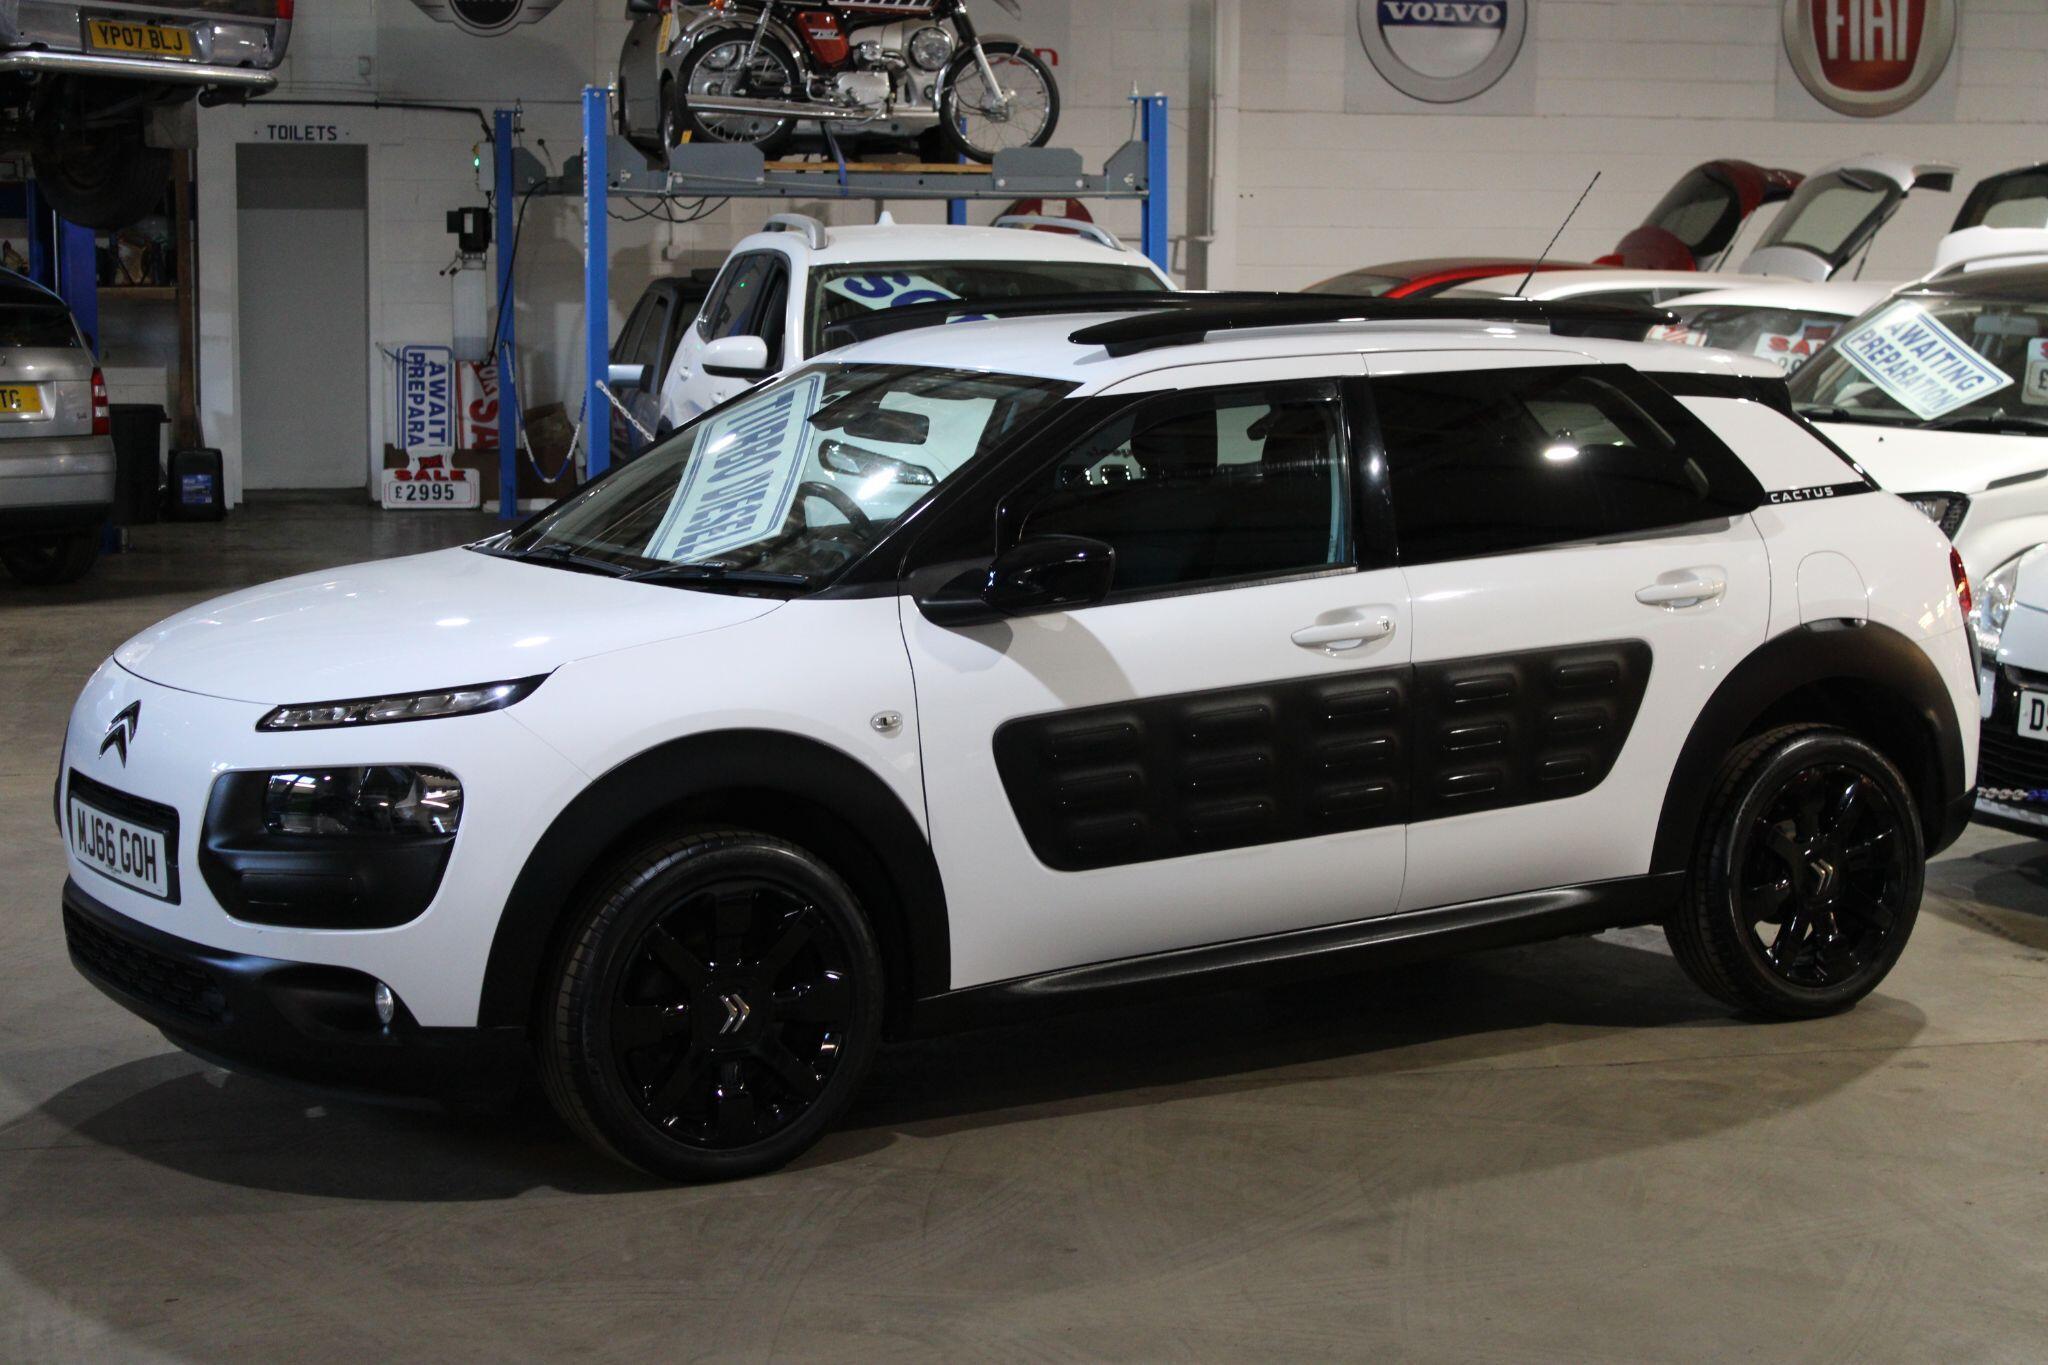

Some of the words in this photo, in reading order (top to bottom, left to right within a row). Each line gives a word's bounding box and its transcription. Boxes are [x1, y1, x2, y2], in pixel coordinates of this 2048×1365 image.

[97, 24, 143, 48] YP07
[147, 29, 183, 51] BLJ
[1383, 1, 1501, 24] VOLVO
[266, 124, 337, 141] TOILETS
[1852, 328, 1960, 409] PREPARATION
[1886, 320, 1985, 391] AWAITING
[428, 360, 446, 447] AWAIT
[707, 389, 796, 483] TURBO
[394, 469, 466, 481] SALE
[1770, 486, 1834, 503] CACTUS
[672, 468, 775, 559] DIESEL
[77, 807, 116, 867] MJ66
[120, 828, 157, 884] GOH
